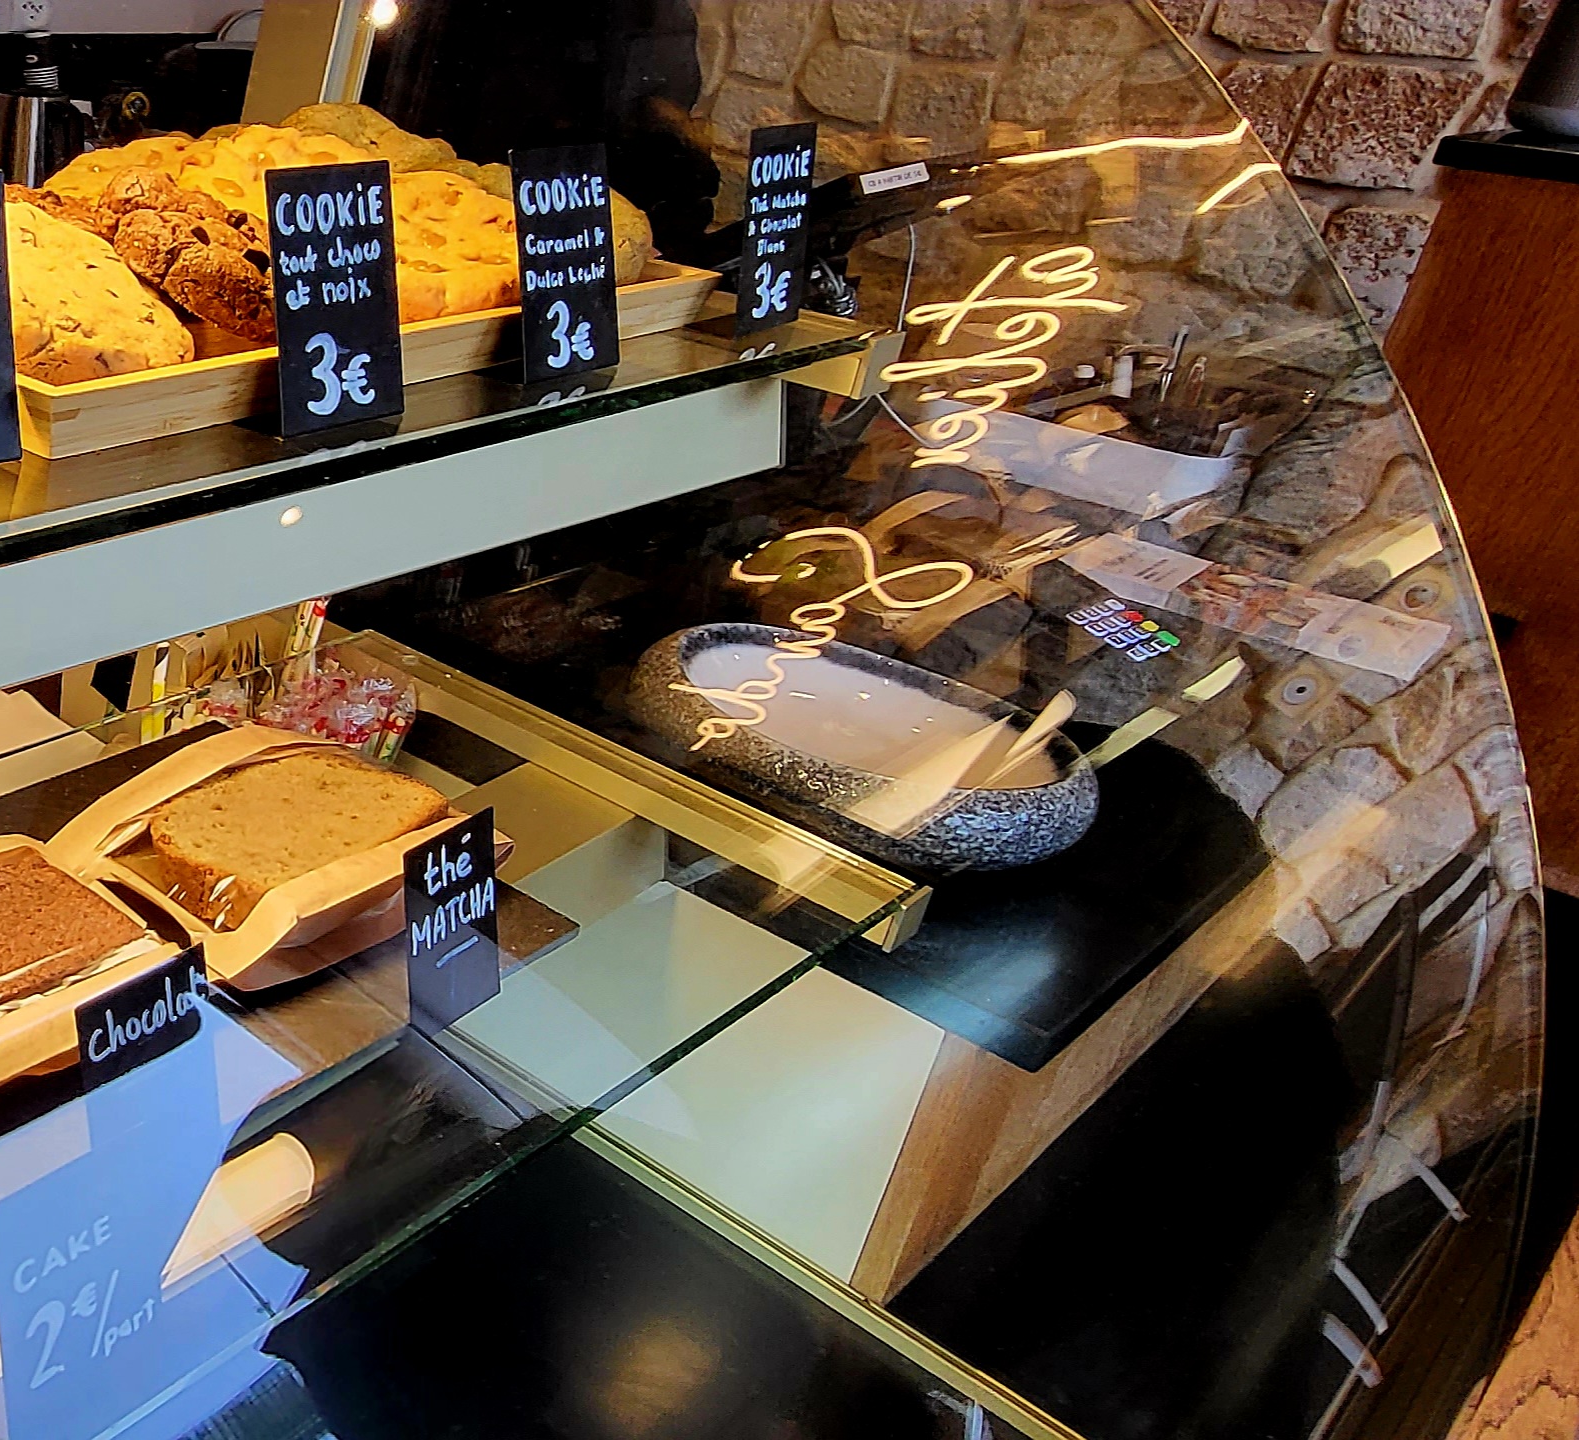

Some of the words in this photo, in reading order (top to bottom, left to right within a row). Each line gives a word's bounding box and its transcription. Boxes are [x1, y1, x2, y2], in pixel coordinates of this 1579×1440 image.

[279, 244, 318, 277] tout
[327, 236, 381, 269] choco
[525, 229, 590, 256] Caramel
[321, 267, 372, 304] noix
[525, 269, 564, 292] Dulce
[752, 261, 792, 319] 3€
[546, 300, 595, 369] 3€
[305, 332, 375, 416] 3€
[424, 832, 473, 896] thé
[412, 876, 495, 957] MATCHA
[13, 1214, 111, 1294] CAKE
